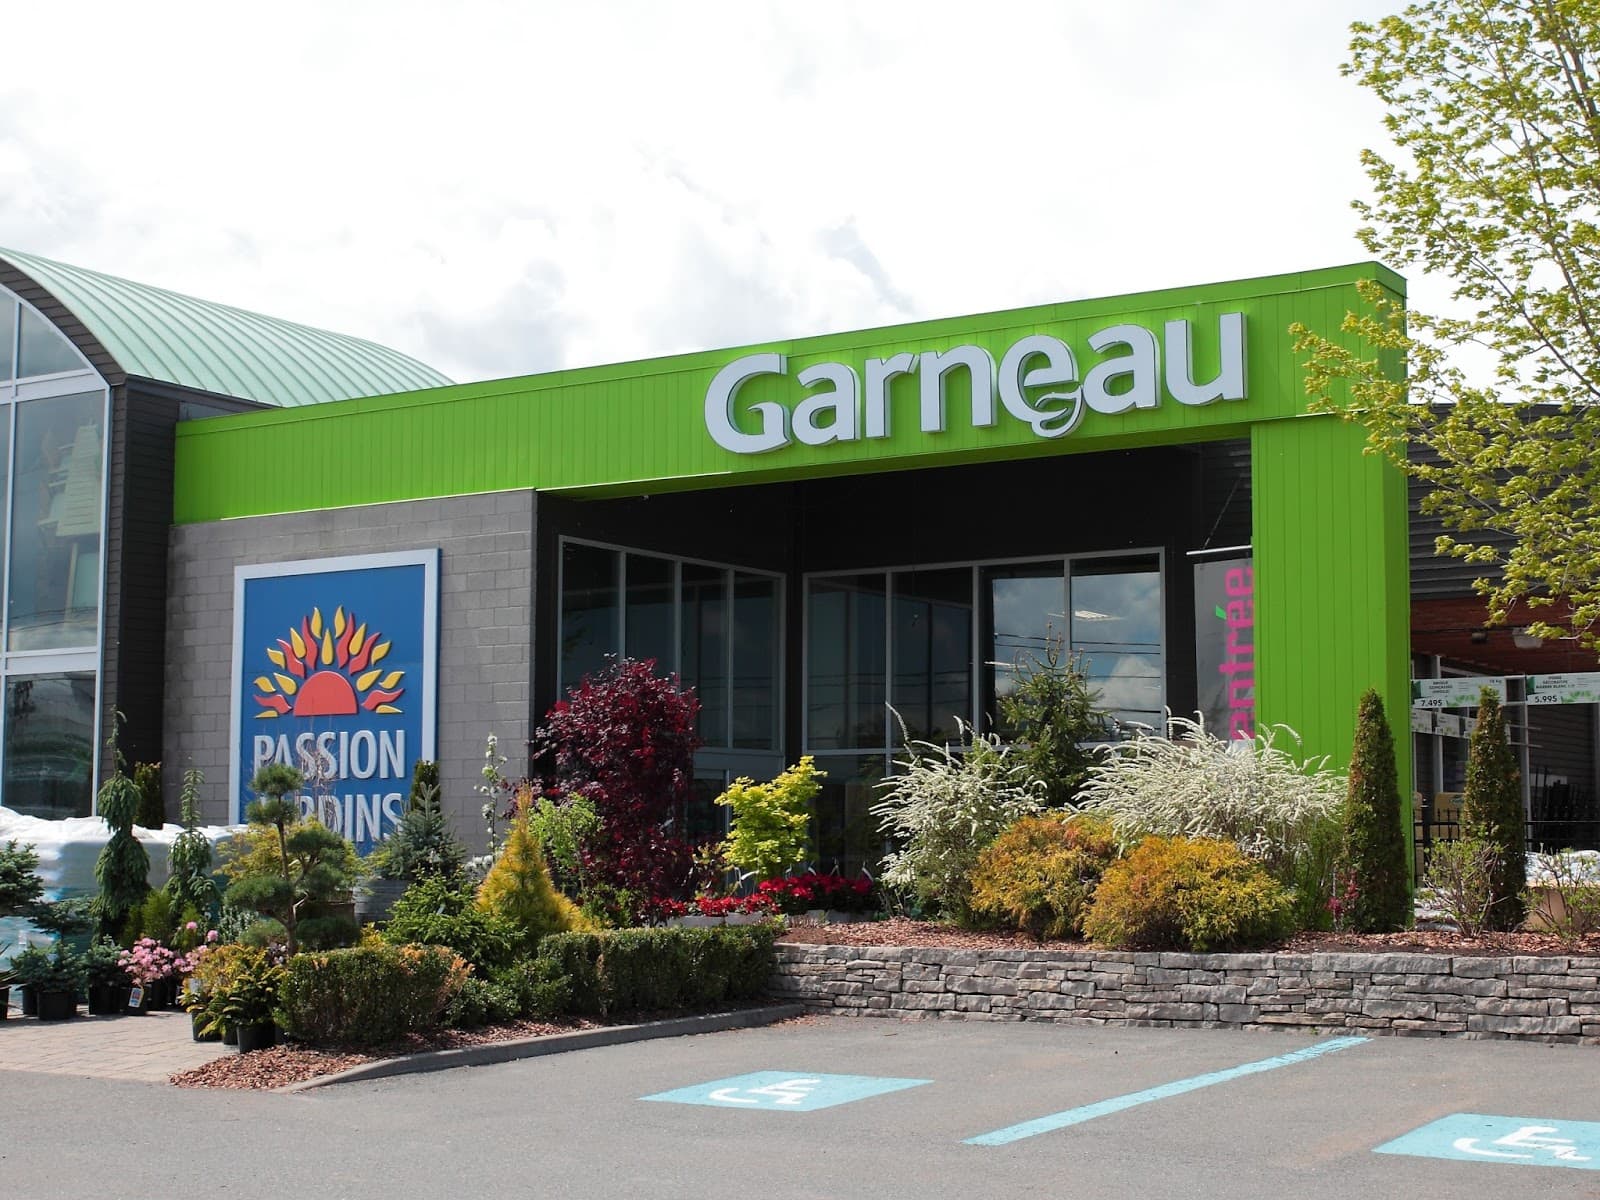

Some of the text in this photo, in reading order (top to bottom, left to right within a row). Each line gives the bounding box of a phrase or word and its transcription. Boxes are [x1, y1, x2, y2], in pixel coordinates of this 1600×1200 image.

[704, 311, 1248, 455] Garneau
[1215, 566, 1255, 740] entrée
[253, 730, 405, 781] PASSION
[256, 793, 404, 844] RDINS
